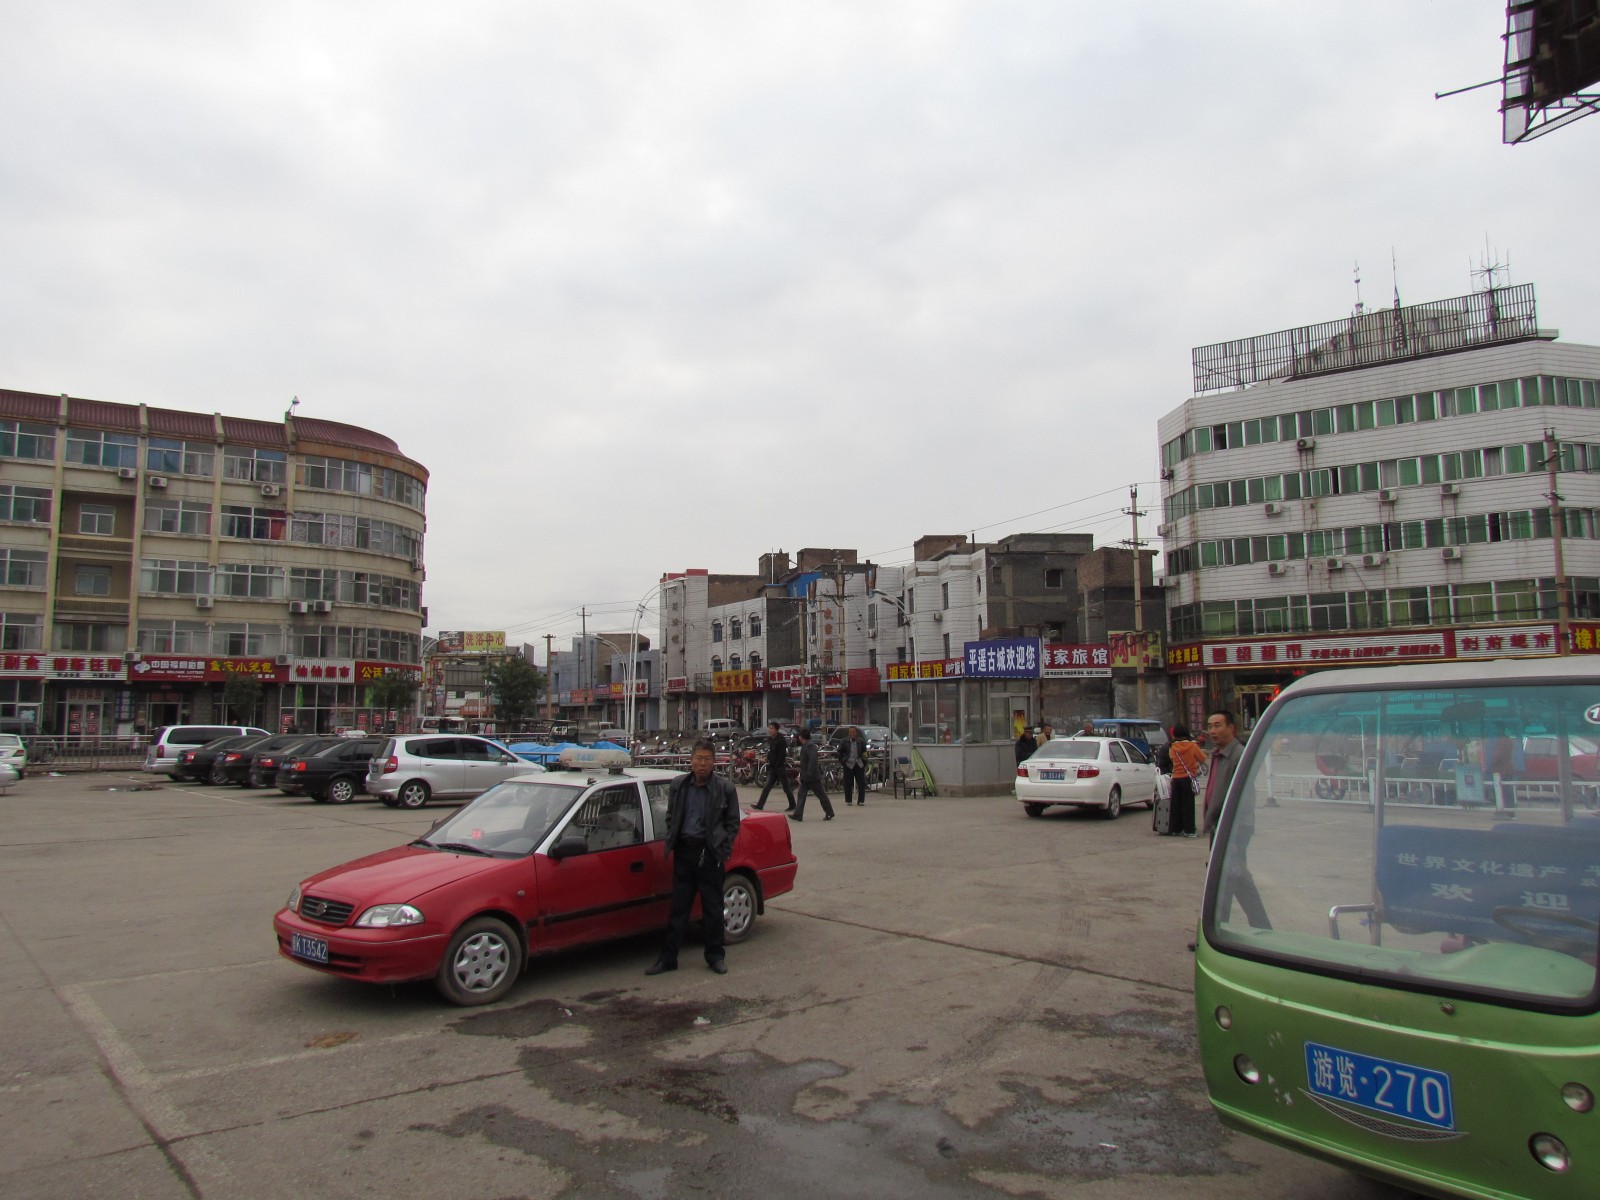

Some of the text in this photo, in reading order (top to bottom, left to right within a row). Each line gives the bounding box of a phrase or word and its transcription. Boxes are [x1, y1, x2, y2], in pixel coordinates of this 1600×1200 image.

[466, 632, 504, 647] 洗浴中心
[151, 660, 205, 670] 中国福利彩票
[969, 644, 1035, 673] 平遥古城欢迎您
[1395, 852, 1567, 878] 世界文化遗产
